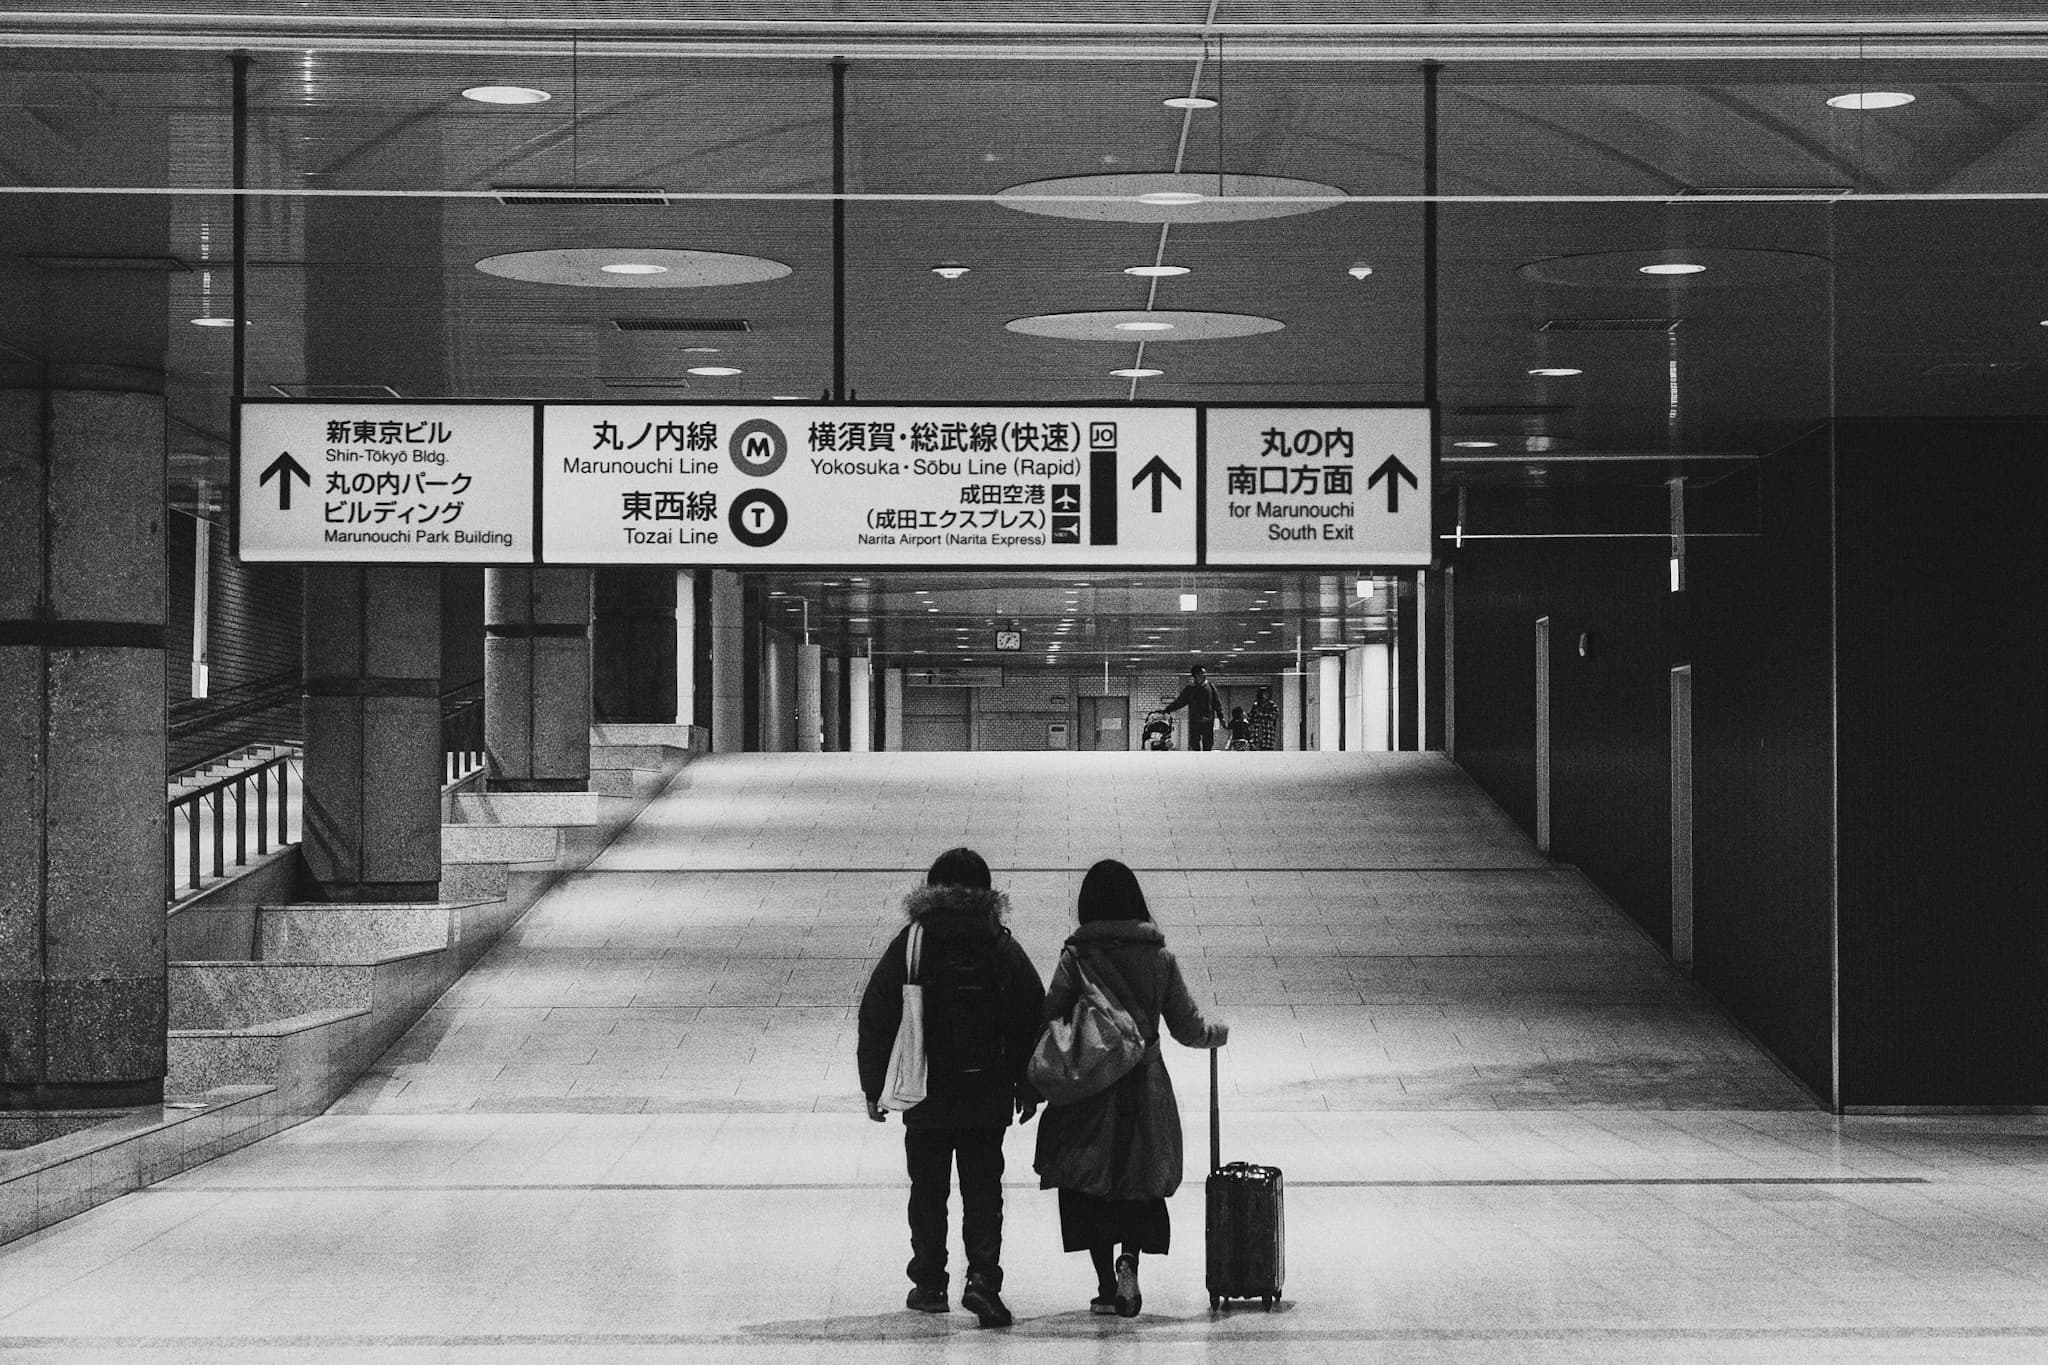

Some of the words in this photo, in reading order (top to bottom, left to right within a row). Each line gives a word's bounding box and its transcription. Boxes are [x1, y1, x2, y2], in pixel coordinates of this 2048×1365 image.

[327, 420, 452, 444] 新東京ビル
[593, 420, 717, 451] 丸ノ内線
[808, 422, 1080, 452] 横須賀・総武線(快速)
[1093, 429, 1113, 442] JO
[746, 438, 770, 457] M
[1261, 427, 1353, 458] 丸の内
[326, 449, 407, 465] Shin-Tōkyō
[413, 450, 448, 466] Bldg.
[564, 458, 672, 473] Marunouchi
[680, 458, 718, 474] Line
[969, 459, 1006, 475] Line
[1014, 458, 1080, 479] (Rapid)
[326, 471, 472, 495] 丸の内パーク
[1227, 464, 1353, 495] 南口方面
[960, 484, 1045, 504] 成田空港
[325, 501, 464, 524] ビルディング
[622, 491, 717, 521] 東西線
[1229, 502, 1251, 518] for
[1257, 502, 1354, 518] Marunouchi
[751, 508, 765, 528] T
[867, 509, 1045, 529] (成田エクスプレス)
[325, 530, 410, 543] Marunouchi
[416, 530, 449, 543] Park
[455, 531, 512, 546] Building
[624, 528, 671, 544] Tozai
[680, 528, 718, 544] Line
[859, 534, 895, 544] Narita
[900, 534, 941, 546] Airport
[946, 533, 987, 547] (Narita
[992, 534, 1045, 547] Express)
[1269, 524, 1317, 540] South
[1323, 524, 1353, 540] Exit
